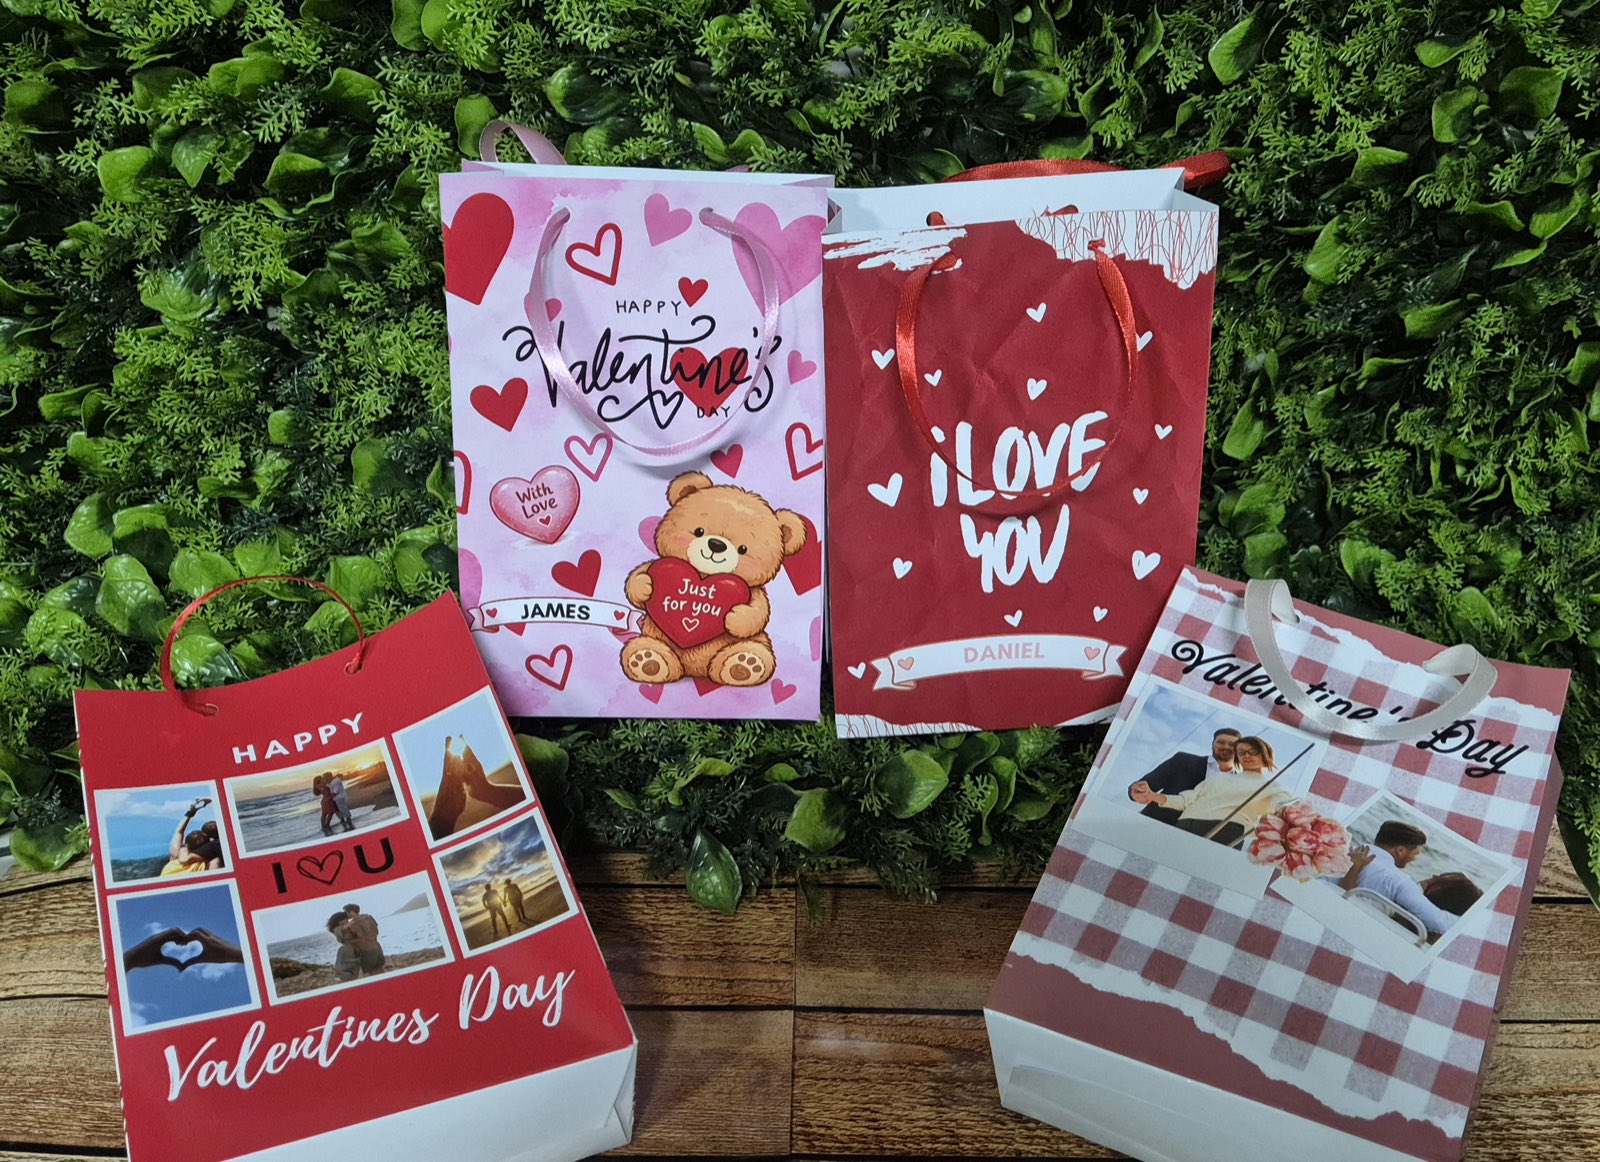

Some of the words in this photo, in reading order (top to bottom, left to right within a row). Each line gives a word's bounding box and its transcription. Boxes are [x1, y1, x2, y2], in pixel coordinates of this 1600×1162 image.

[615, 299, 682, 316] HAPPY
[501, 314, 783, 429] Valentine's
[696, 406, 731, 419] DAY
[516, 484, 553, 504] With
[522, 497, 558, 519] Love
[959, 503, 1070, 594] YOU
[677, 578, 717, 599] Just
[520, 603, 591, 621] JAMES
[662, 596, 689, 612] for
[691, 599, 722, 617] you
[963, 643, 1045, 663] DANIEL
[232, 713, 364, 765] HAPPY
[1415, 719, 1530, 778] Day
[271, 861, 287, 894] I
[354, 837, 395, 875] U
[163, 1006, 440, 1102] Valentines
[457, 965, 577, 1030] Day
